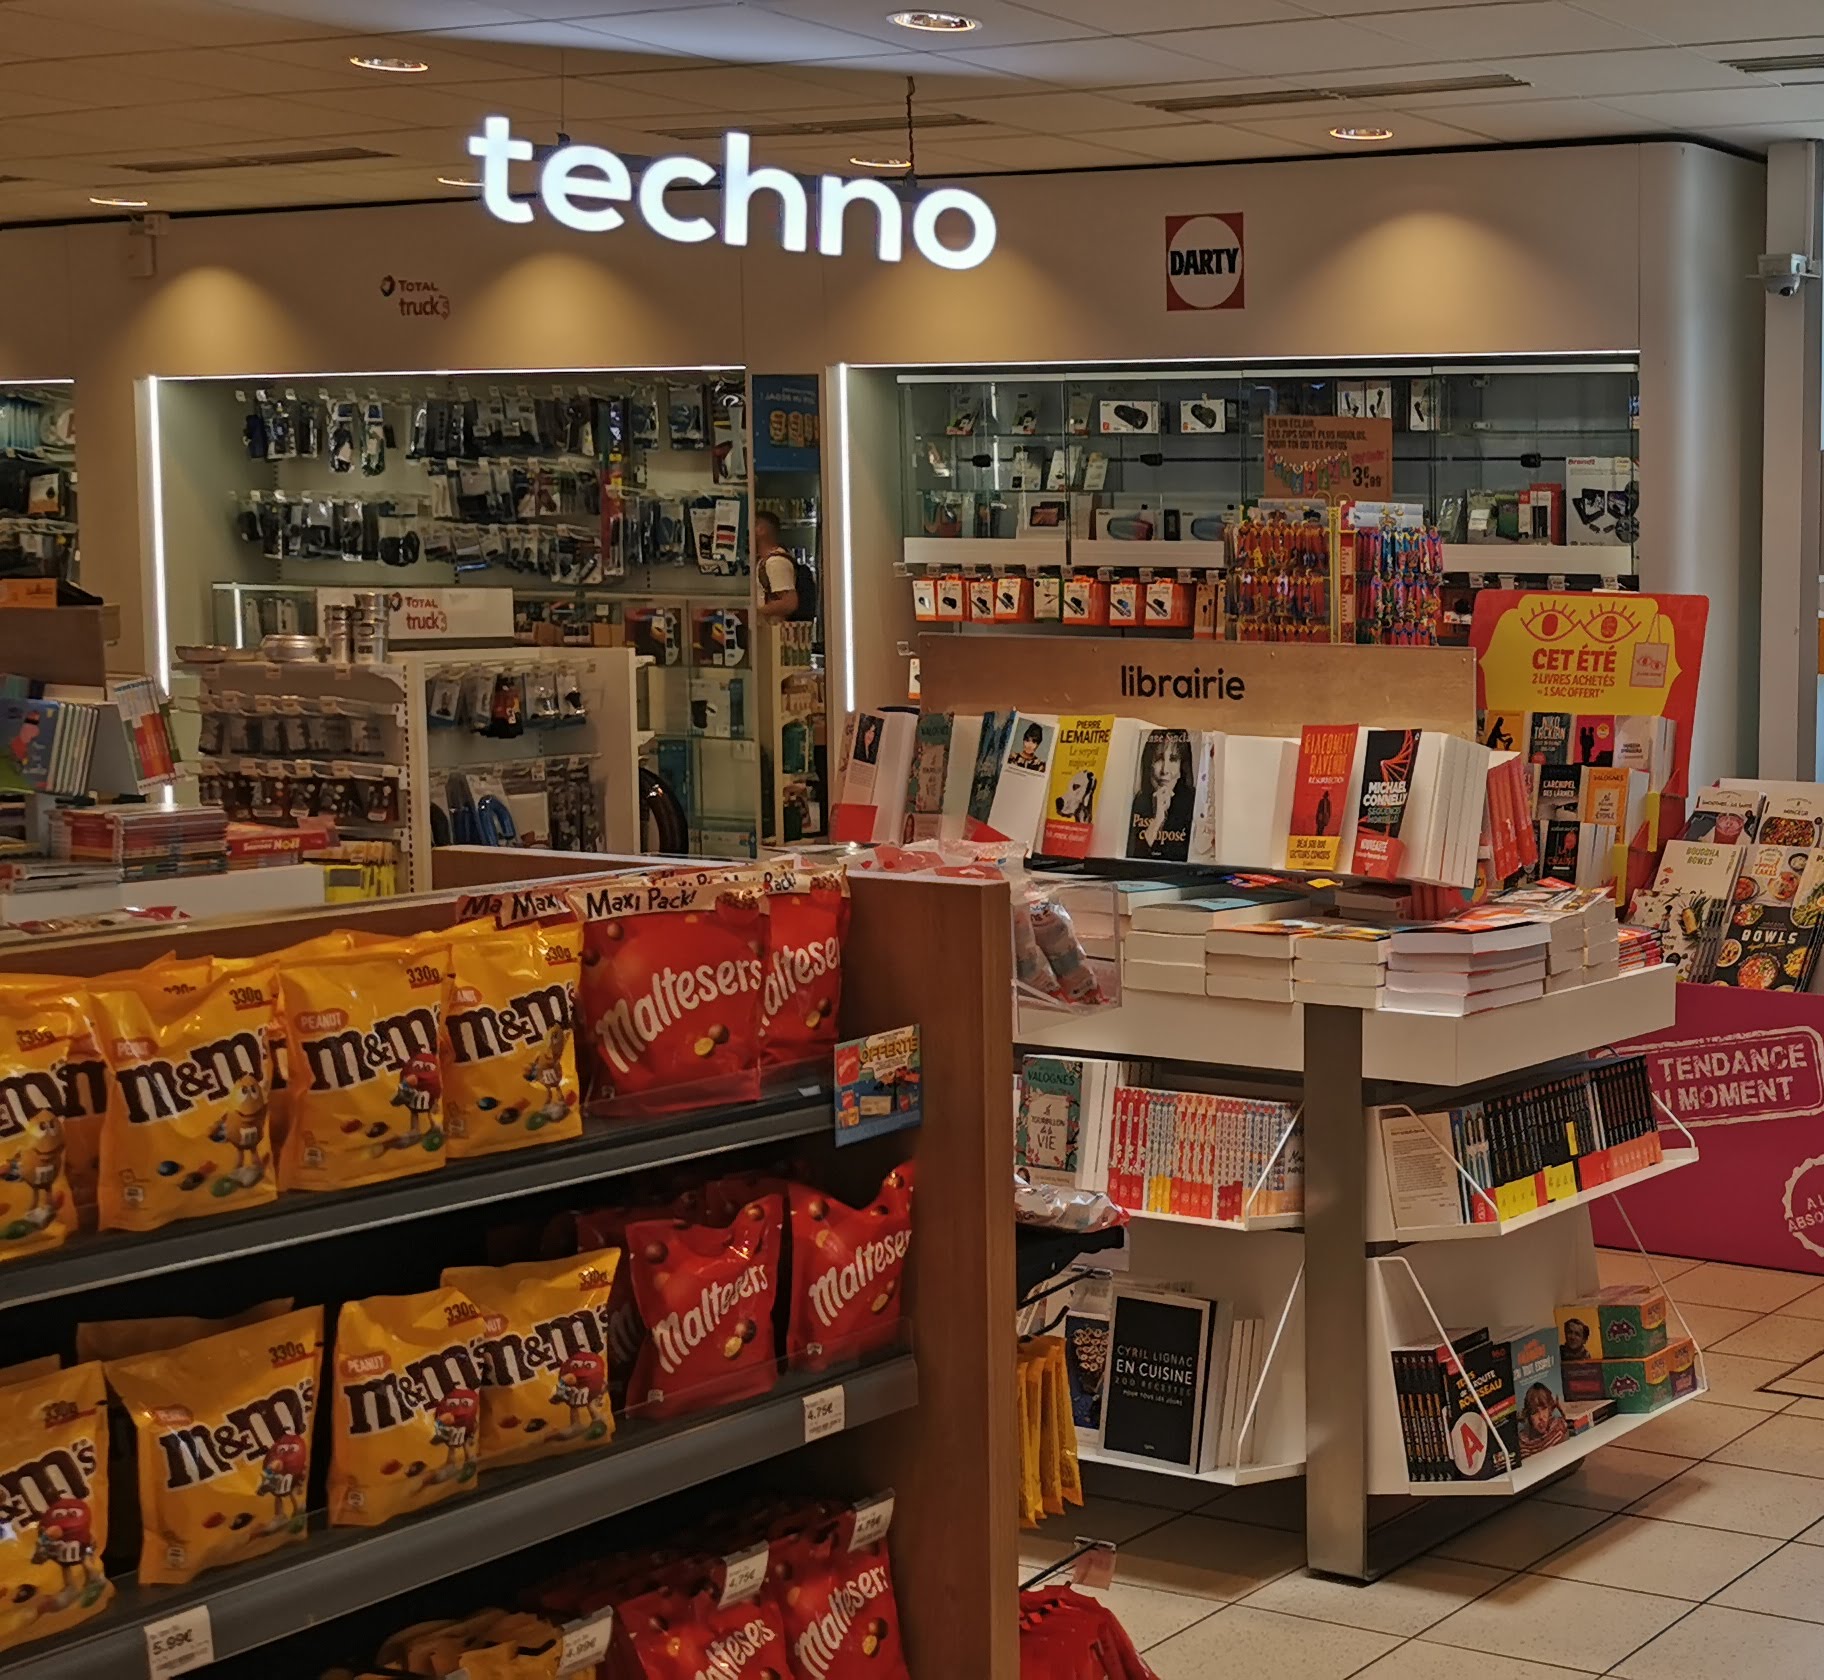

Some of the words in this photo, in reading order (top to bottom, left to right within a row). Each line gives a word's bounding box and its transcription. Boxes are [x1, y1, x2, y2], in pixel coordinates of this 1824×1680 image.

[467, 116, 997, 270] techno
[1169, 249, 1240, 276] DARTY
[398, 280, 439, 292] TOTAL
[405, 596, 438, 608] TOTAL
[1532, 647, 1574, 671] CET
[1576, 643, 1617, 672] ÉTÉ
[1120, 664, 1245, 702] librairie
[1538, 673, 1571, 686] LIVRES
[1572, 673, 1616, 687] ACHETÉS
[1549, 687, 1567, 698] SAC
[1060, 728, 1111, 744] LEMAITRE
[1368, 781, 1407, 794] MICHAEL
[1362, 793, 1408, 806] CONNELLY
[1687, 856, 1714, 866] BOWLS
[586, 888, 641, 919] Maxi
[646, 887, 698, 911] Pack!
[1741, 929, 1798, 943] BOWLS
[407, 965, 440, 986] 330g
[300, 1012, 343, 1031] PEANUT
[596, 959, 763, 1074] Maltesers
[1657, 1043, 1808, 1083] TENDANCE
[1028, 1069, 1075, 1086] VALOGNES
[1678, 1075, 1794, 1112] MOMENT
[1037, 1134, 1056, 1150] VIE
[1806, 1196, 1818, 1210] A
[652, 1261, 769, 1374] Maltesers
[270, 1341, 306, 1364] 330g
[1117, 1345, 1149, 1360] CYRIL
[1153, 1350, 1193, 1367] LIGNAC
[346, 1356, 386, 1375] PEANUT
[1116, 1358, 1135, 1374] EN
[1138, 1362, 1193, 1385] CUISINE
[1460, 1423, 1485, 1469] A
